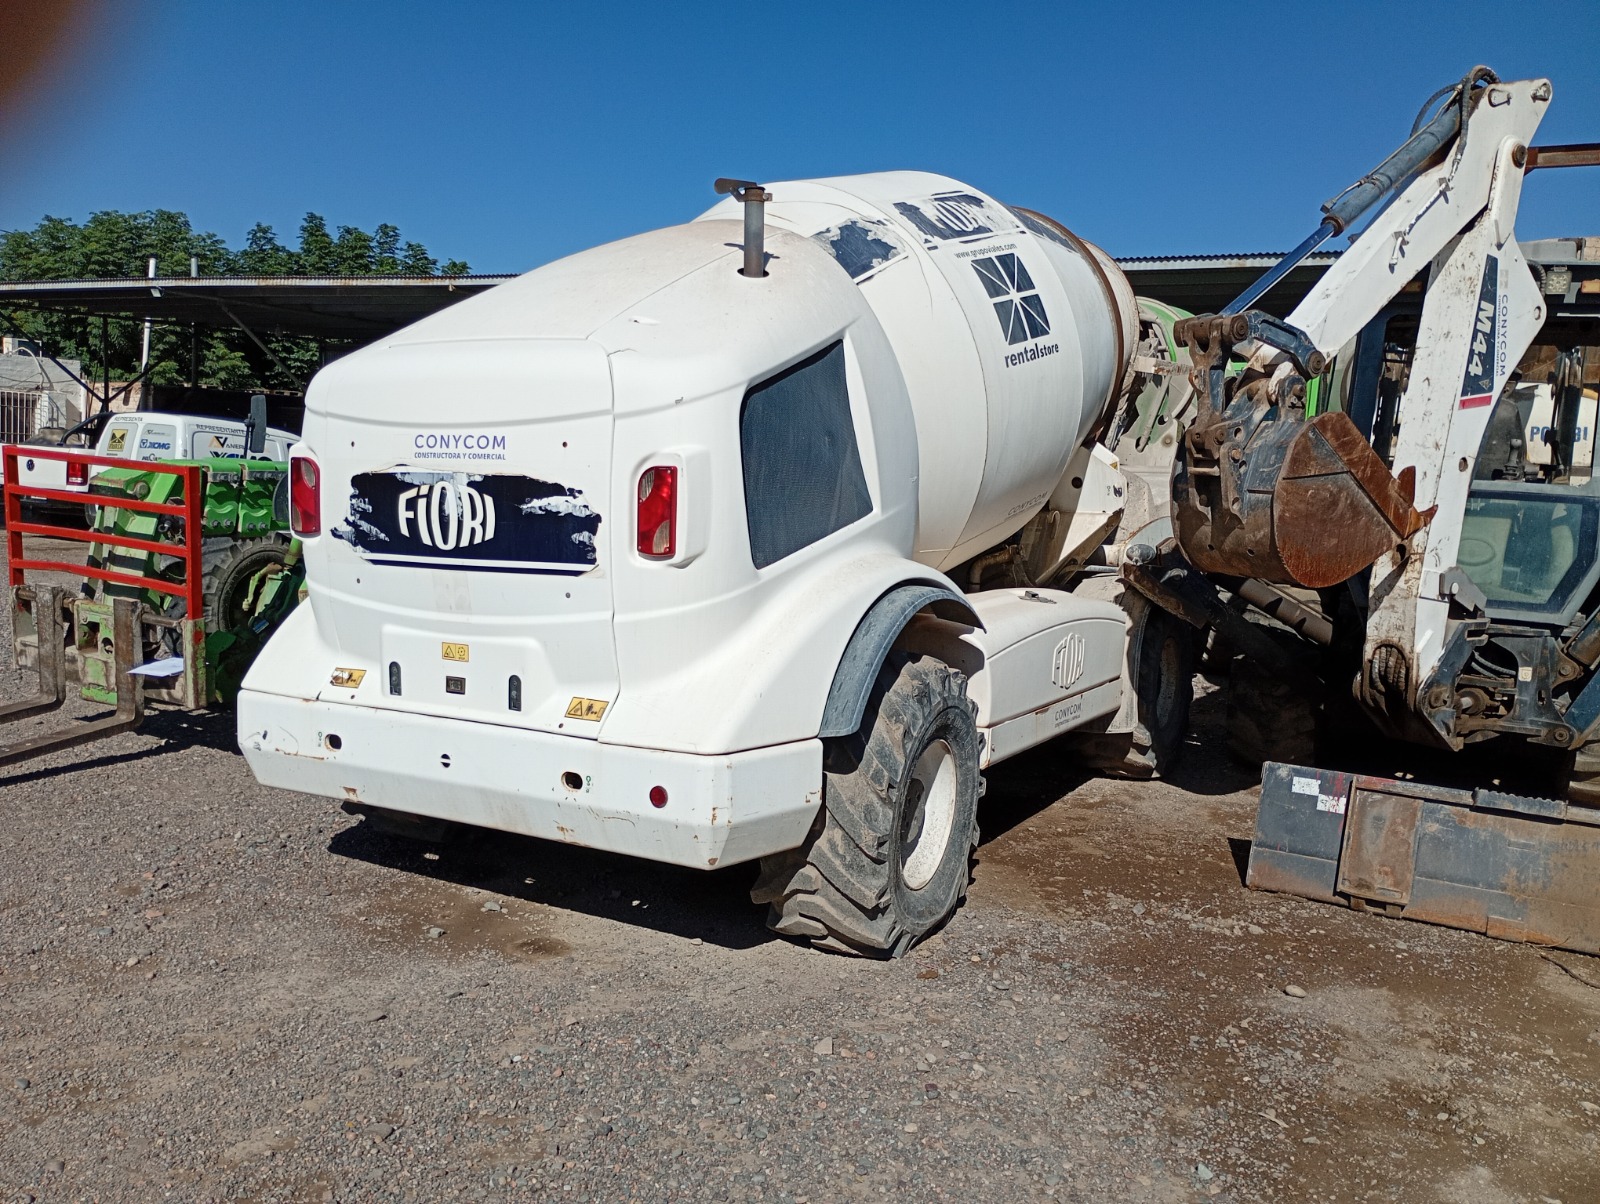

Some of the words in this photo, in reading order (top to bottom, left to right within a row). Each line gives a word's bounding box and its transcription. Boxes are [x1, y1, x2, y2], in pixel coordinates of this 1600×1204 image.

[954, 243, 1018, 258] www.grupoviales.com
[1468, 300, 1494, 376] M44
[1500, 294, 1508, 376] CONYCOM
[414, 434, 506, 450] CONYCOM
[414, 451, 461, 459] CONSTRUCTORA
[1054, 703, 1082, 721] CONYCOM
